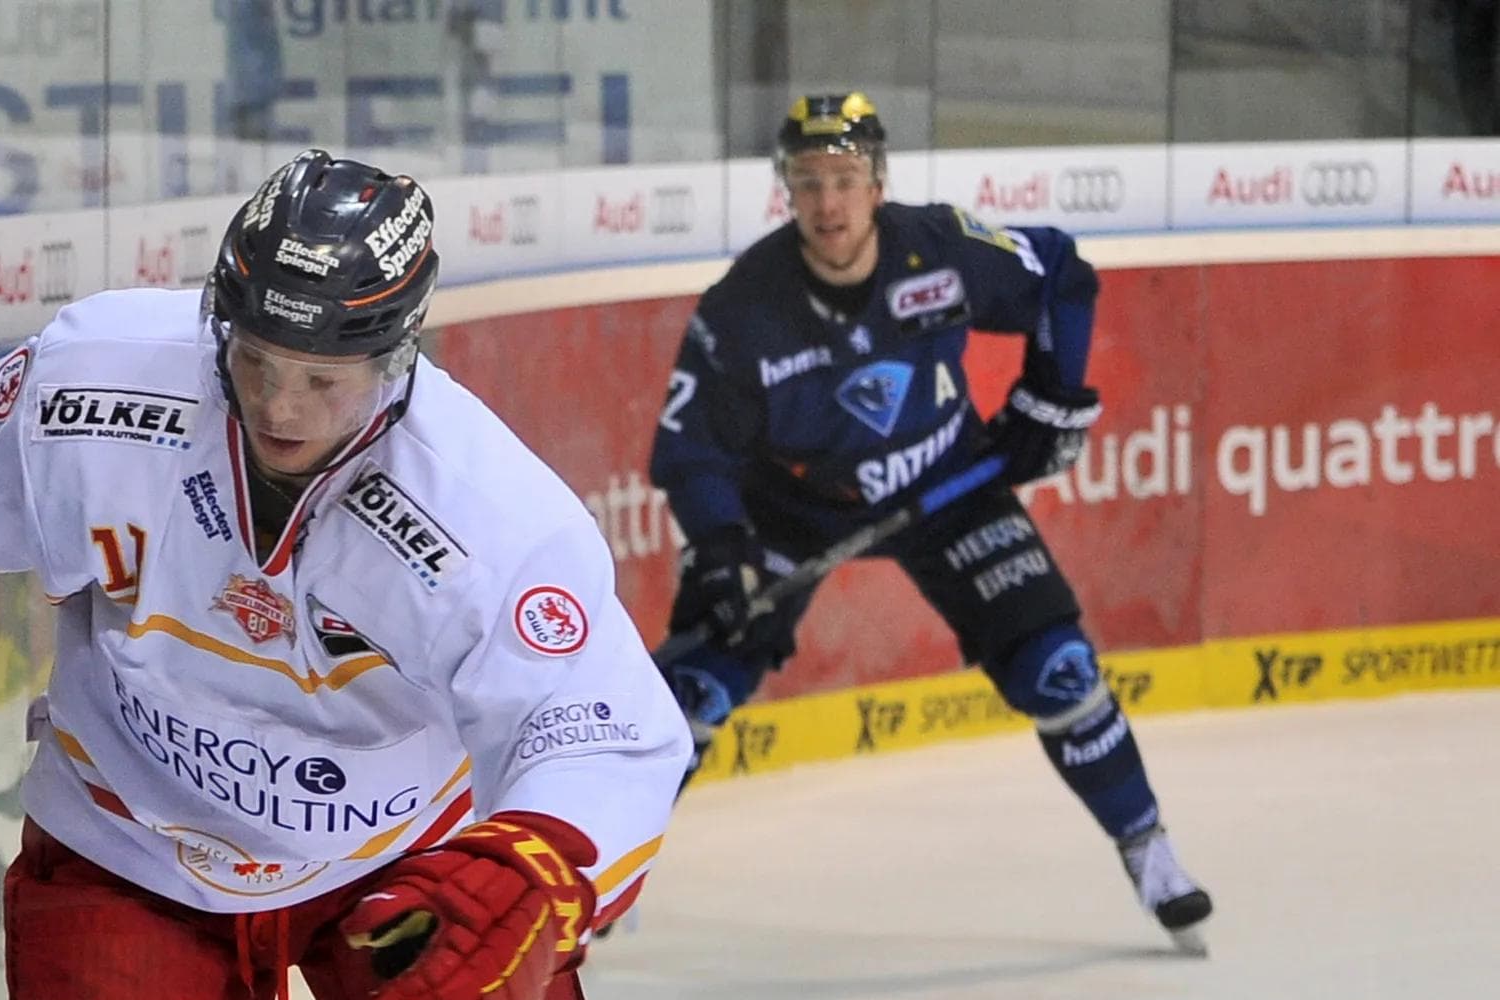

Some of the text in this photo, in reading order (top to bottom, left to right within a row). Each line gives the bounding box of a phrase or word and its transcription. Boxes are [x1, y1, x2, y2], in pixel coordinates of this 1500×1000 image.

[976, 173, 1050, 212] Audi
[1208, 165, 1292, 205] Audi
[364, 186, 425, 258] Effecten
[275, 249, 330, 277] Spiegel
[279, 238, 340, 269] Effecten
[378, 209, 432, 281] Spiegel
[263, 300, 314, 324] Spiegel
[265, 288, 323, 315] Effecten
[934, 361, 957, 409] A
[39, 393, 186, 436] VÖLKEL
[183, 476, 217, 540] Spiegel
[197, 470, 233, 542] Effecten
[347, 472, 449, 573] VÖLKEL
[525, 609, 548, 644] DEG
[112, 671, 290, 785] ENERGY
[519, 723, 640, 760] CONSULTING
[1063, 714, 1128, 766] ham
[119, 702, 420, 832] CONSULTING
